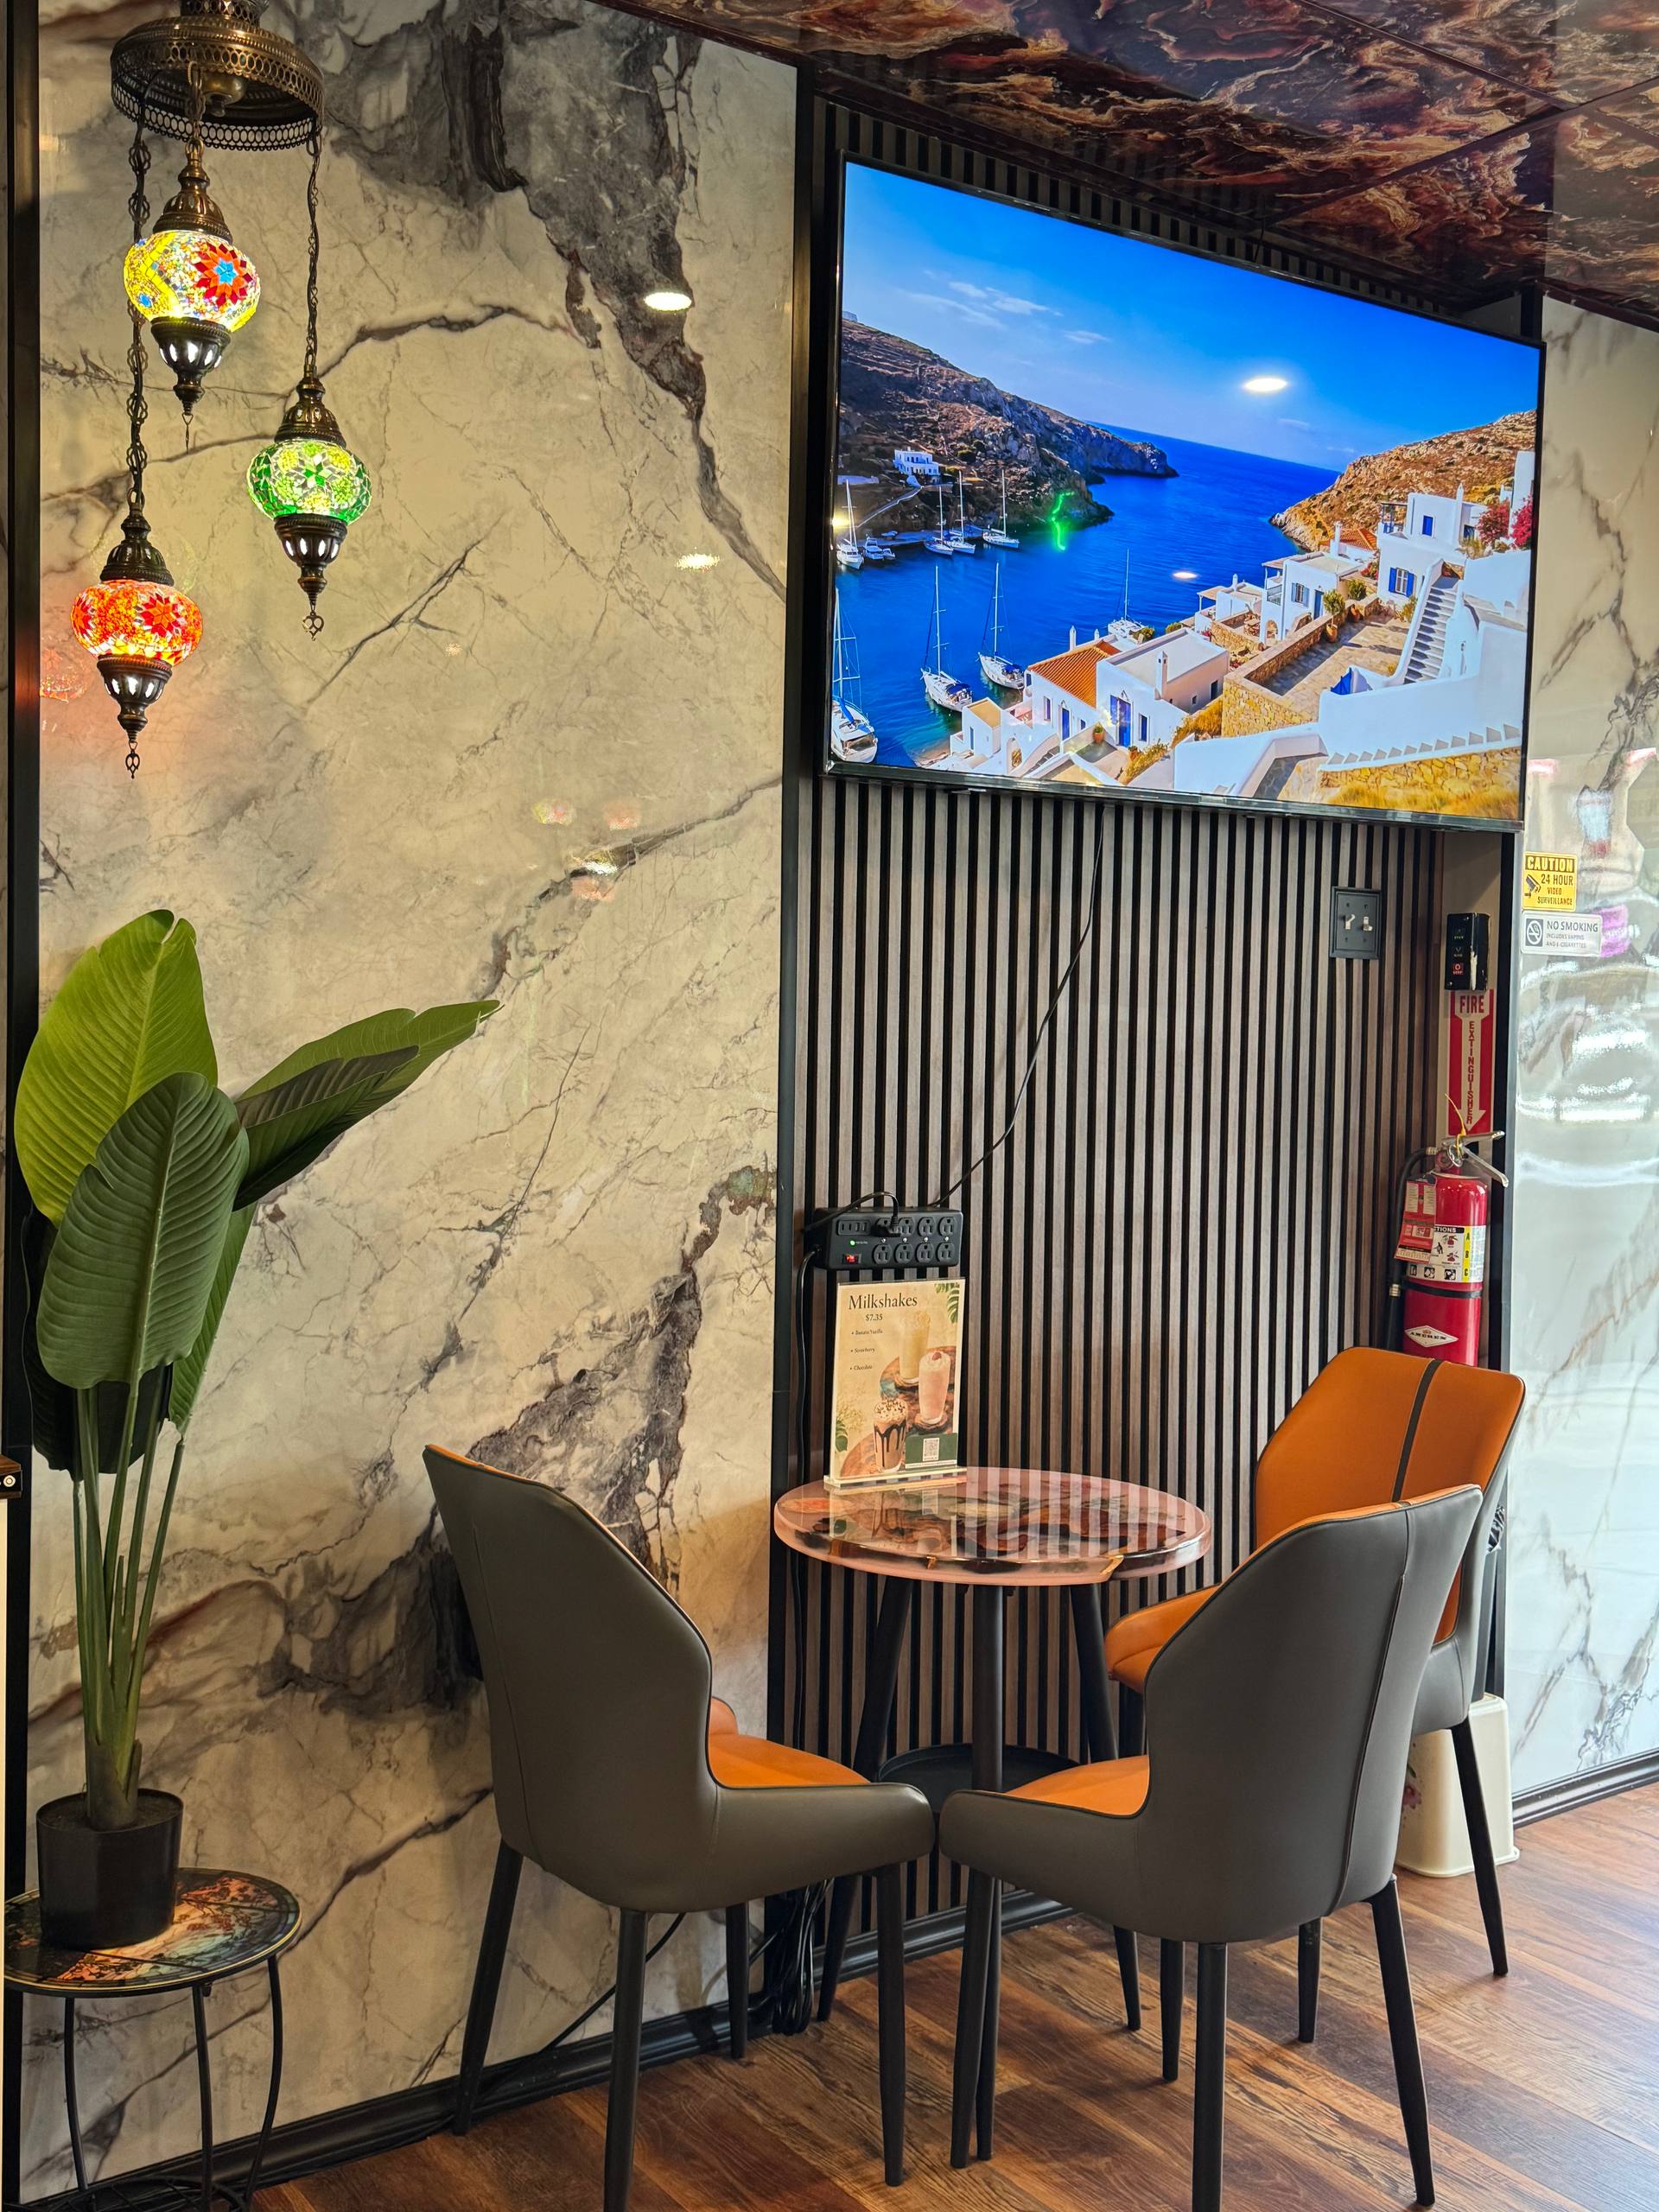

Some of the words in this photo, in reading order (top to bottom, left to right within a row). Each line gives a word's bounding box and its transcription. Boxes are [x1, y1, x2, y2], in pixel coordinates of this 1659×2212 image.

[1527, 856, 1573, 871] CAUTION
[1541, 874, 1550, 884] 24
[1553, 874, 1573, 886] HOUR
[1537, 896, 1573, 906] SURVEILLANCE
[1547, 920, 1559, 930] NO
[1560, 921, 1599, 932] SMOKING
[1459, 995, 1484, 1014] FIRE
[1465, 1020, 1475, 1124] EXTINGUISHER
[849, 1293, 918, 1310] Milkshakes
[865, 1313, 883, 1322] $7.35
